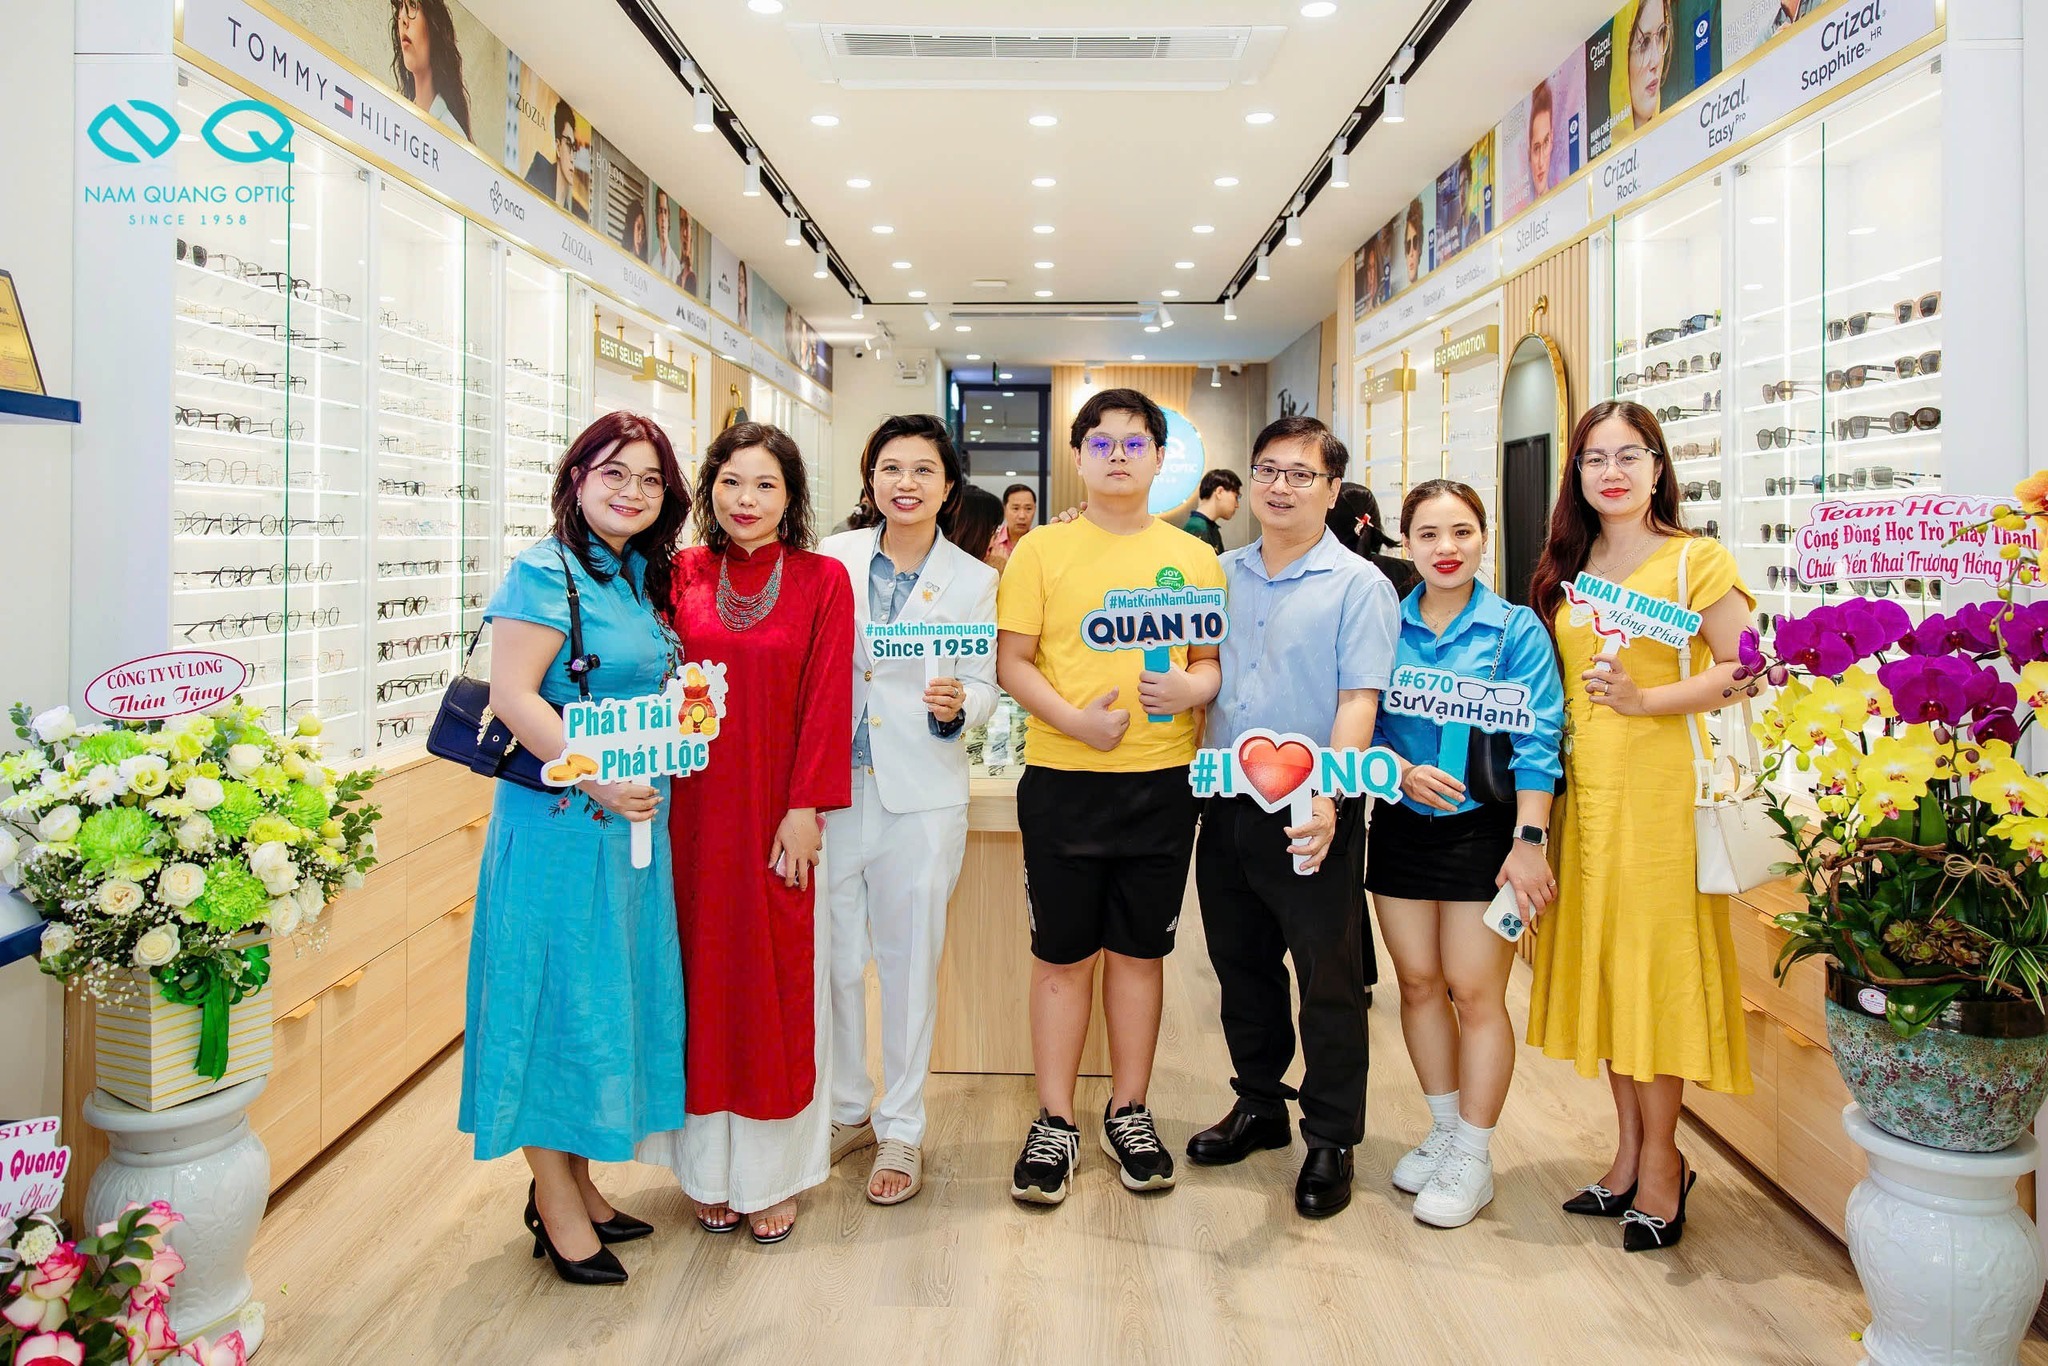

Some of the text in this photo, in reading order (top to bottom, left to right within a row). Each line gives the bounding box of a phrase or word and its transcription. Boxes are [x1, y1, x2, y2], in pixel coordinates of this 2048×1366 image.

[1821, 0, 1882, 51] Crizal HR
[1590, 32, 1611, 61] Crizal
[1593, 56, 1606, 71] Easy
[1801, 42, 1865, 91] Sapphire
[228, 16, 440, 172] TOMMY HILFIGER
[1700, 79, 1746, 129] Crizal
[515, 93, 547, 132] ZIOZIA
[1709, 112, 1746, 148] Easy Pro
[1603, 149, 1637, 188] Crizal
[1617, 178, 1638, 200] Rock
[504, 198, 525, 221] ancci
[562, 231, 593, 266] ZIOZIA
[1516, 216, 1549, 252] Stellest
[624, 267, 649, 292] BOLON
[601, 338, 643, 368] BEST SELLER
[1447, 333, 1486, 361] PROMOTION
[1819, 505, 1896, 521] Team
[1804, 528, 1838, 552] Cộng
[1844, 524, 1880, 546] Đồng
[1885, 520, 1914, 546] Học
[1919, 520, 1944, 541] Trò
[1870, 553, 1904, 573] Khai
[1109, 591, 1221, 609] #MatKinhNamQuang
[1576, 574, 1700, 633] KHAI TRƯƠNG
[865, 622, 995, 637] #matkinhnamquang
[1088, 611, 1222, 645] QUẬN 10
[1606, 609, 1686, 647] Hồng Phát
[873, 638, 989, 657] Since 1958
[107, 670, 145, 690] CÔNG
[148, 667, 166, 684] TY
[188, 659, 223, 677] LONG
[1398, 671, 1454, 694] #670
[108, 685, 225, 714] Thân Tặng
[1389, 690, 1531, 728] SưVạnHạnh
[569, 698, 672, 738] Phát Tài
[602, 740, 707, 780] Phát Lộc
[1322, 751, 1399, 800] NQ
[10, 1149, 67, 1182] Quang
